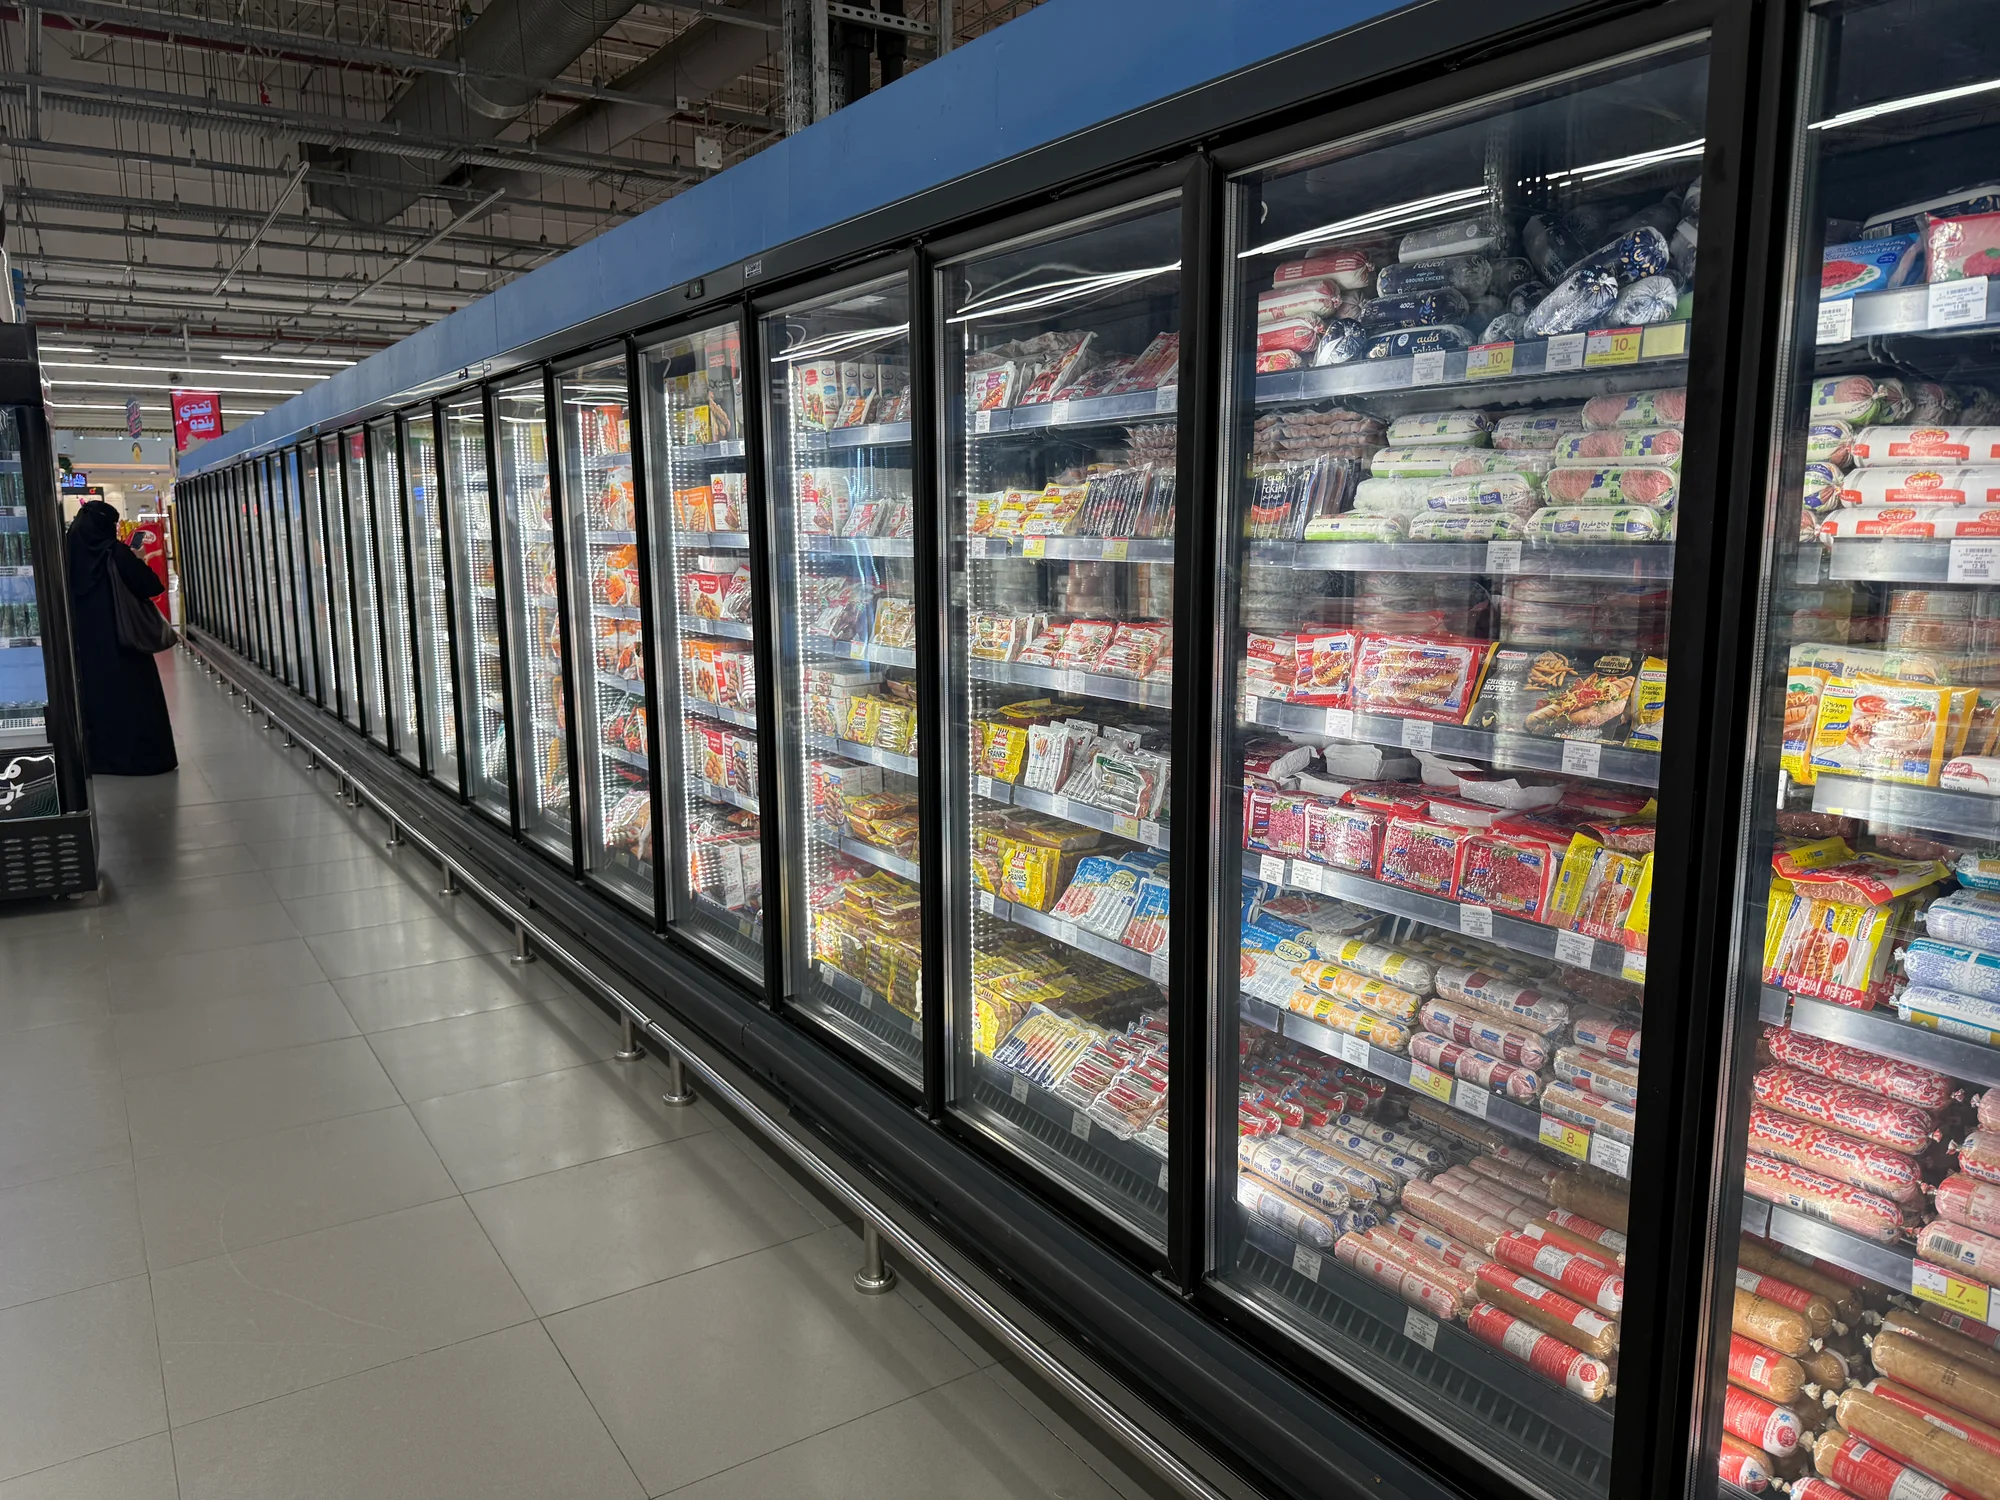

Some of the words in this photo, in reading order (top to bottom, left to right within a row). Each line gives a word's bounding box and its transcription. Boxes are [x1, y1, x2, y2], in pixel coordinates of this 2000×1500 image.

[180, 400, 212, 420] تحدي
[190, 415, 215, 431] بنده
[1912, 433, 1946, 443] Seara
[1907, 477, 1940, 487] Seara
[1879, 511, 1914, 521] Seara
[1981, 512, 2000, 521] Sea
[1251, 641, 1273, 651] Seara
[1484, 684, 1516, 692] HOTDOG
[1486, 678, 1518, 687] CHICKEN
[1826, 686, 1855, 695] MERICANA
[1787, 974, 1822, 996] SPECIAL
[1824, 984, 1854, 1001] OFFER
[1434, 1077, 1440, 1088] 8
[1784, 1096, 1806, 1110] MINCED
[1804, 1101, 1823, 1113] LAMB
[1834, 1112, 1859, 1126] MINCED
[1858, 1118, 1877, 1130] LAMB
[1566, 1131, 1575, 1144] 8
[1756, 1123, 1778, 1137] MINCED
[1777, 1129, 1795, 1140] LAMB
[1815, 1142, 1838, 1157] MINCED
[1837, 1148, 1857, 1161] LAMB
[1762, 1160, 1780, 1171] LAMB
[1869, 1160, 1894, 1174] MINCED
[1790, 1171, 1813, 1184] MINCED
[1812, 1178, 1832, 1190] LAMB
[1322, 1199, 1338, 1209] SUPER
[1852, 1193, 1877, 1208] MINCED
[1955, 1284, 1967, 1299] 7
